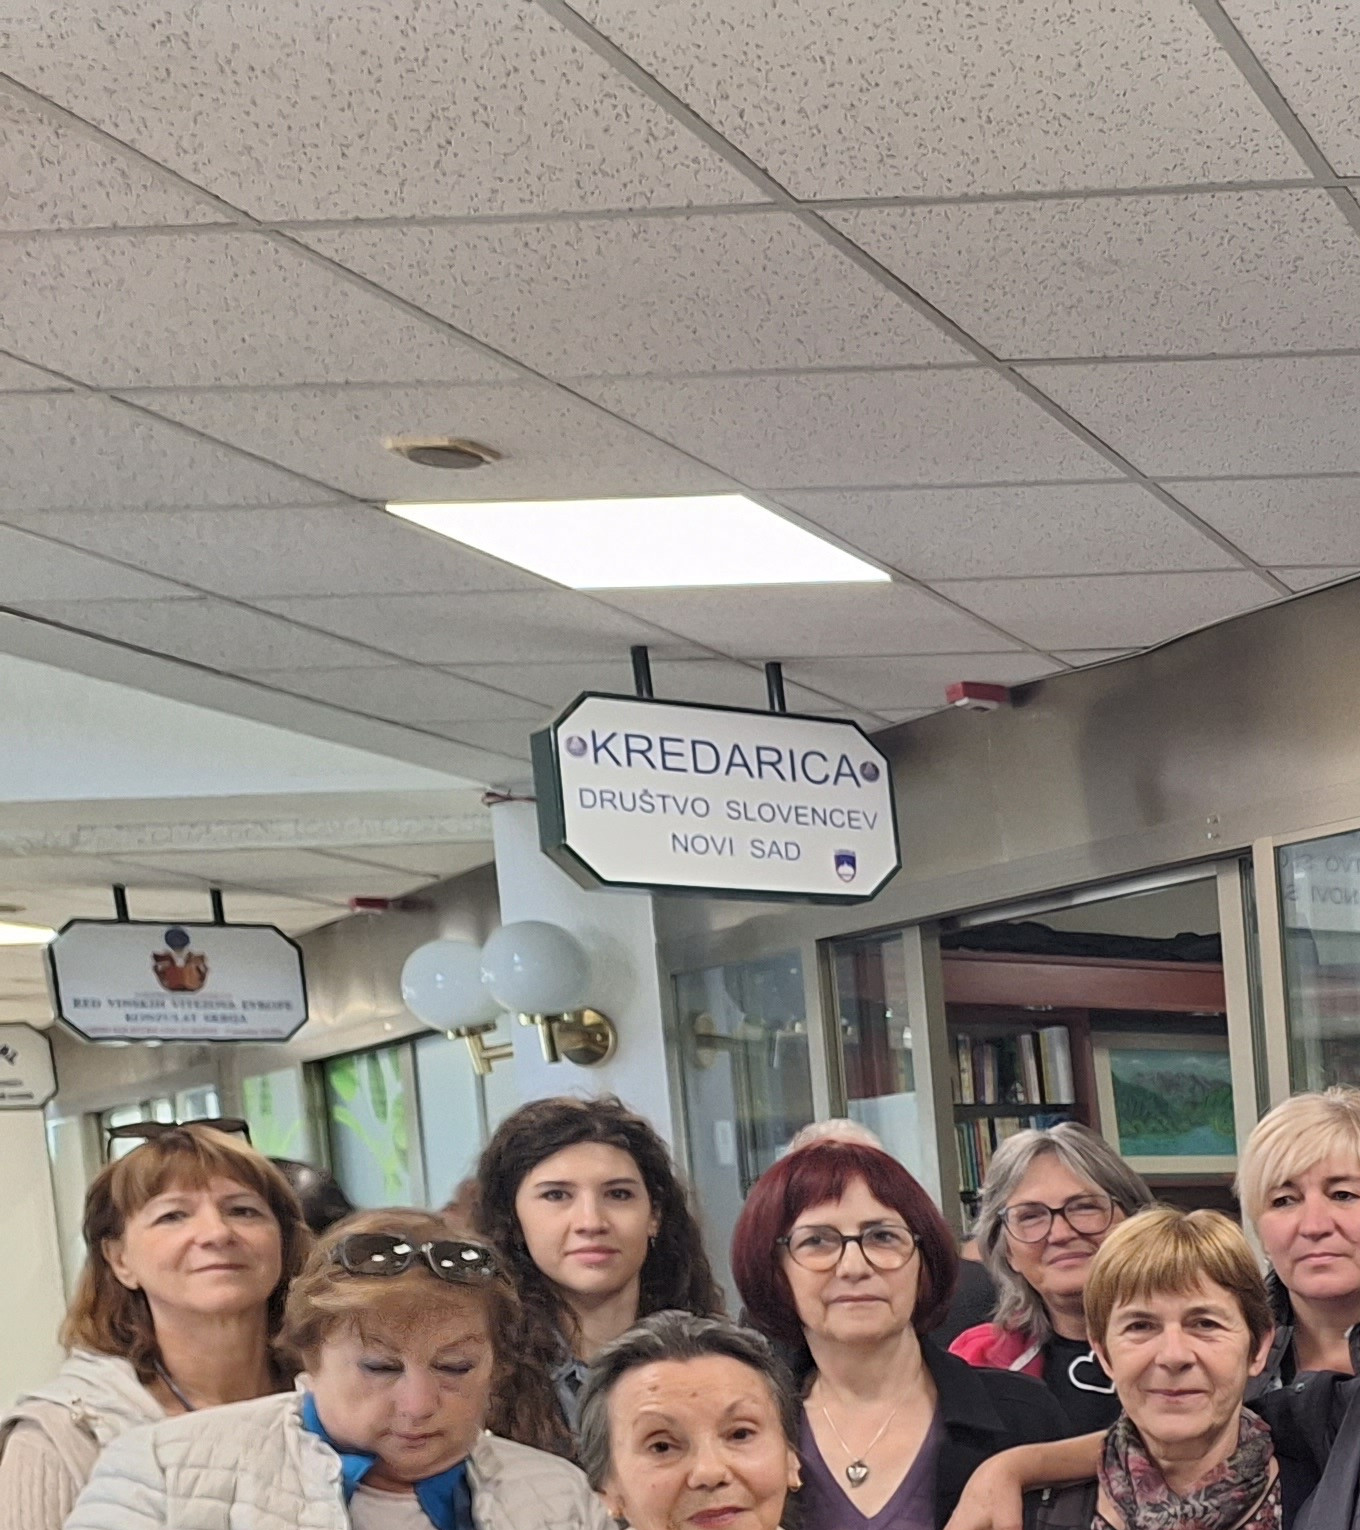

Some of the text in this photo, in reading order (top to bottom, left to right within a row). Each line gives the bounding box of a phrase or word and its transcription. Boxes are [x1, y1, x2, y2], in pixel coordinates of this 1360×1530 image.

[590, 729, 862, 788] KREDARICA
[579, 788, 878, 830] DRUŠTVO SLOVENCEV
[671, 832, 801, 861] NOVI SAD
